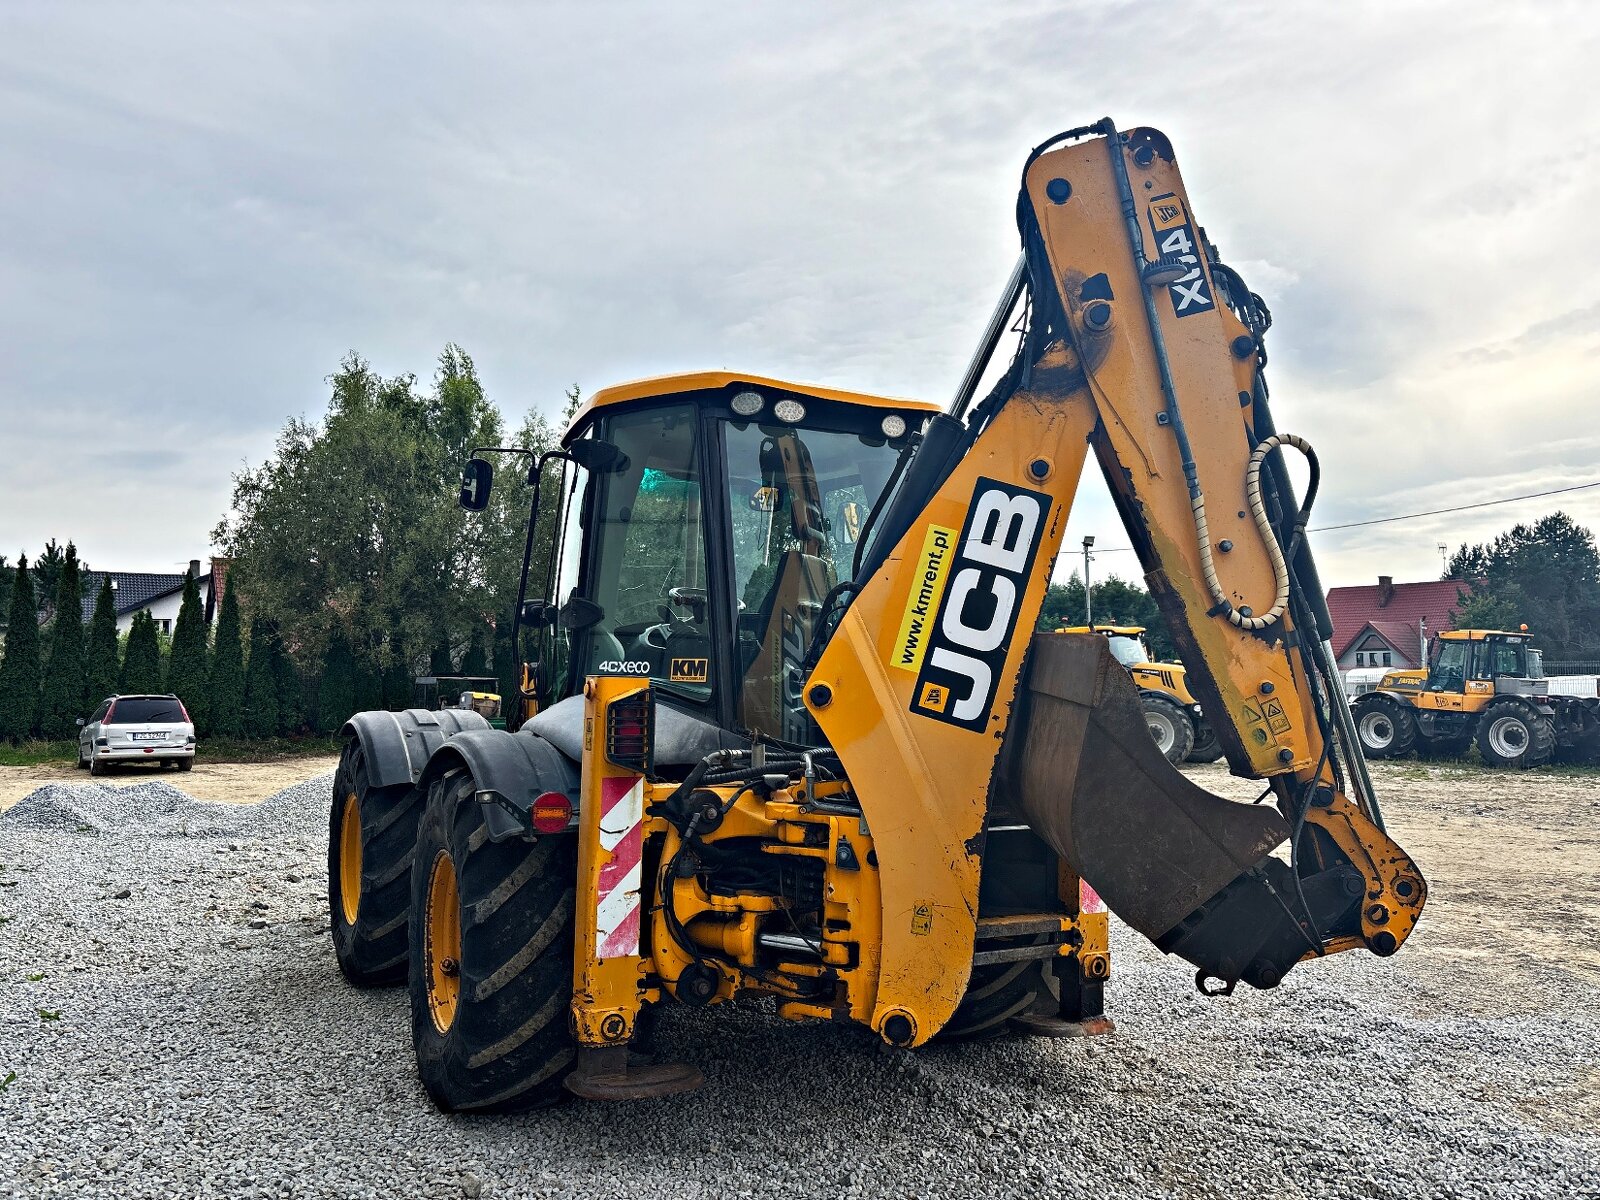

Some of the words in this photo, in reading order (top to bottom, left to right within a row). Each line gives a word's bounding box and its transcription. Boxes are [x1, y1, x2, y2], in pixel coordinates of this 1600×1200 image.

[1159, 206, 1180, 221] JCB
[901, 530, 949, 665] www.kmrent.pl
[930, 489, 1041, 721] JCB
[598, 660, 651, 674] 4CXeco
[672, 660, 707, 676] KM
[926, 688, 941, 704] JCB
